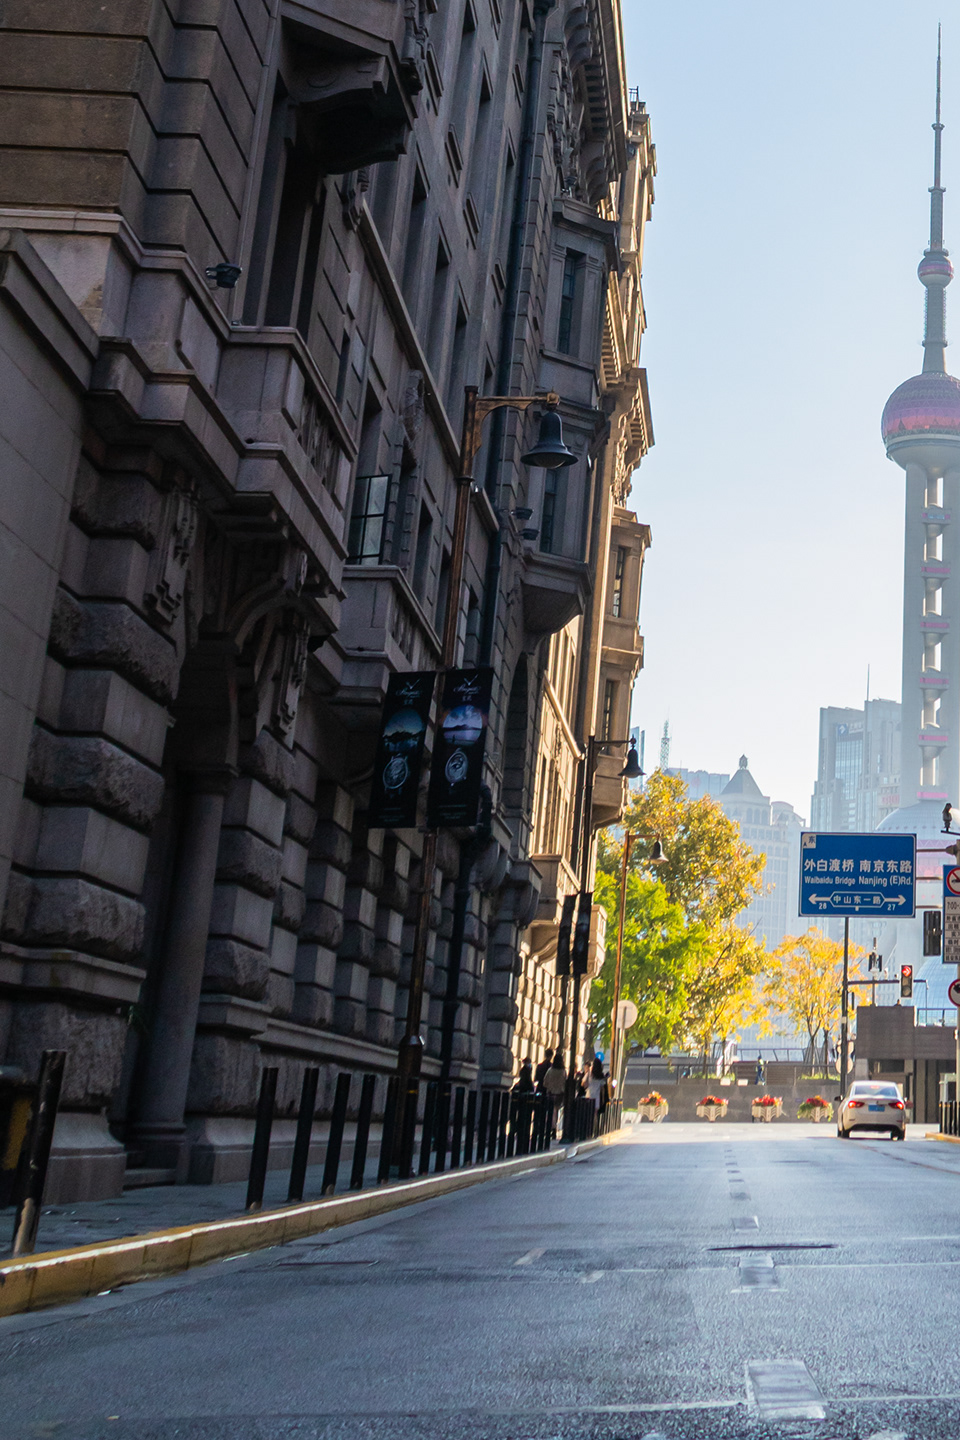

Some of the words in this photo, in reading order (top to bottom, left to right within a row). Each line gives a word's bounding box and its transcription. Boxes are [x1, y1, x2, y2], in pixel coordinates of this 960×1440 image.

[808, 835, 816, 844] 东
[804, 858, 854, 872] 外白渡桥
[859, 859, 912, 873] 南京东路
[804, 875, 833, 884] Waibaidu
[835, 876, 855, 886] Bridge
[858, 876, 887, 887] Nanjing
[833, 895, 881, 905] 中山东一路
